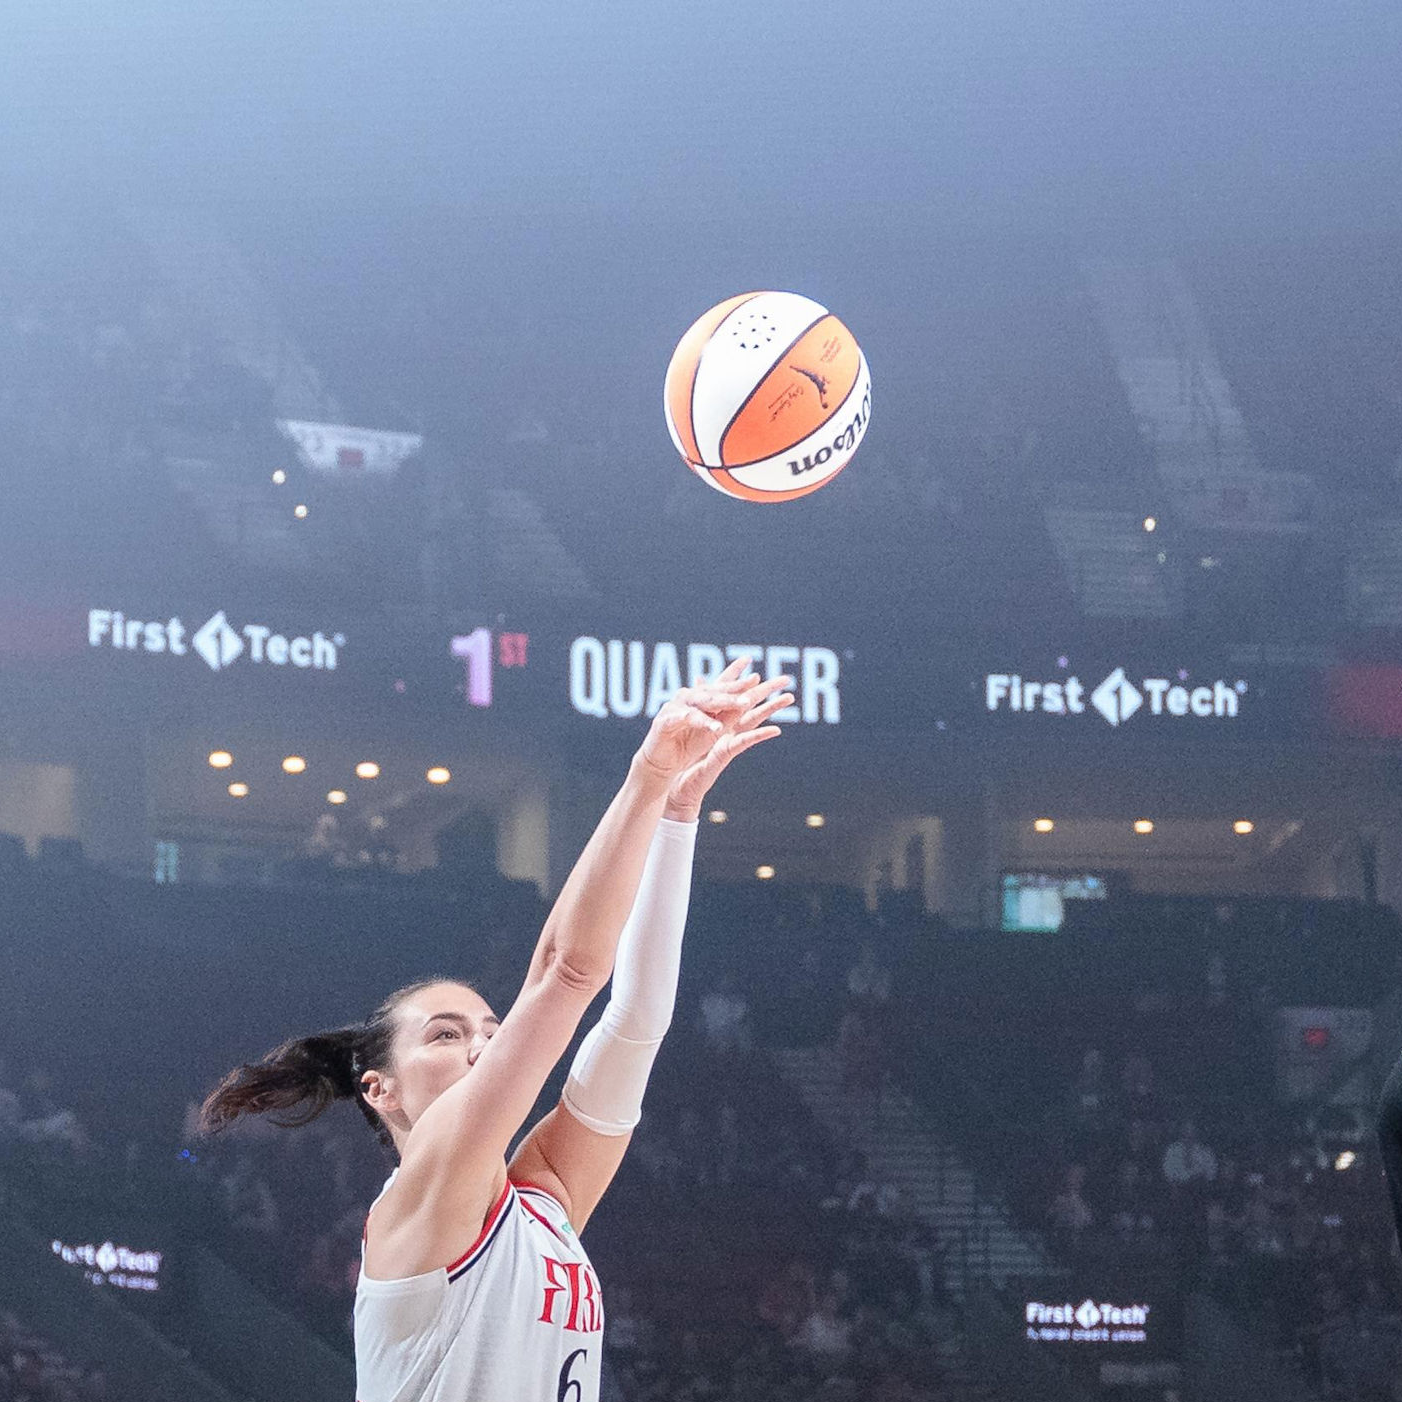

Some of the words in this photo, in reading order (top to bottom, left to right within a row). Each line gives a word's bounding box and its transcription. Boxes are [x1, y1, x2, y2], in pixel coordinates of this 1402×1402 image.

[88, 609, 186, 656] First
[986, 674, 1084, 714] First
[537, 1254, 602, 1333] FIR
